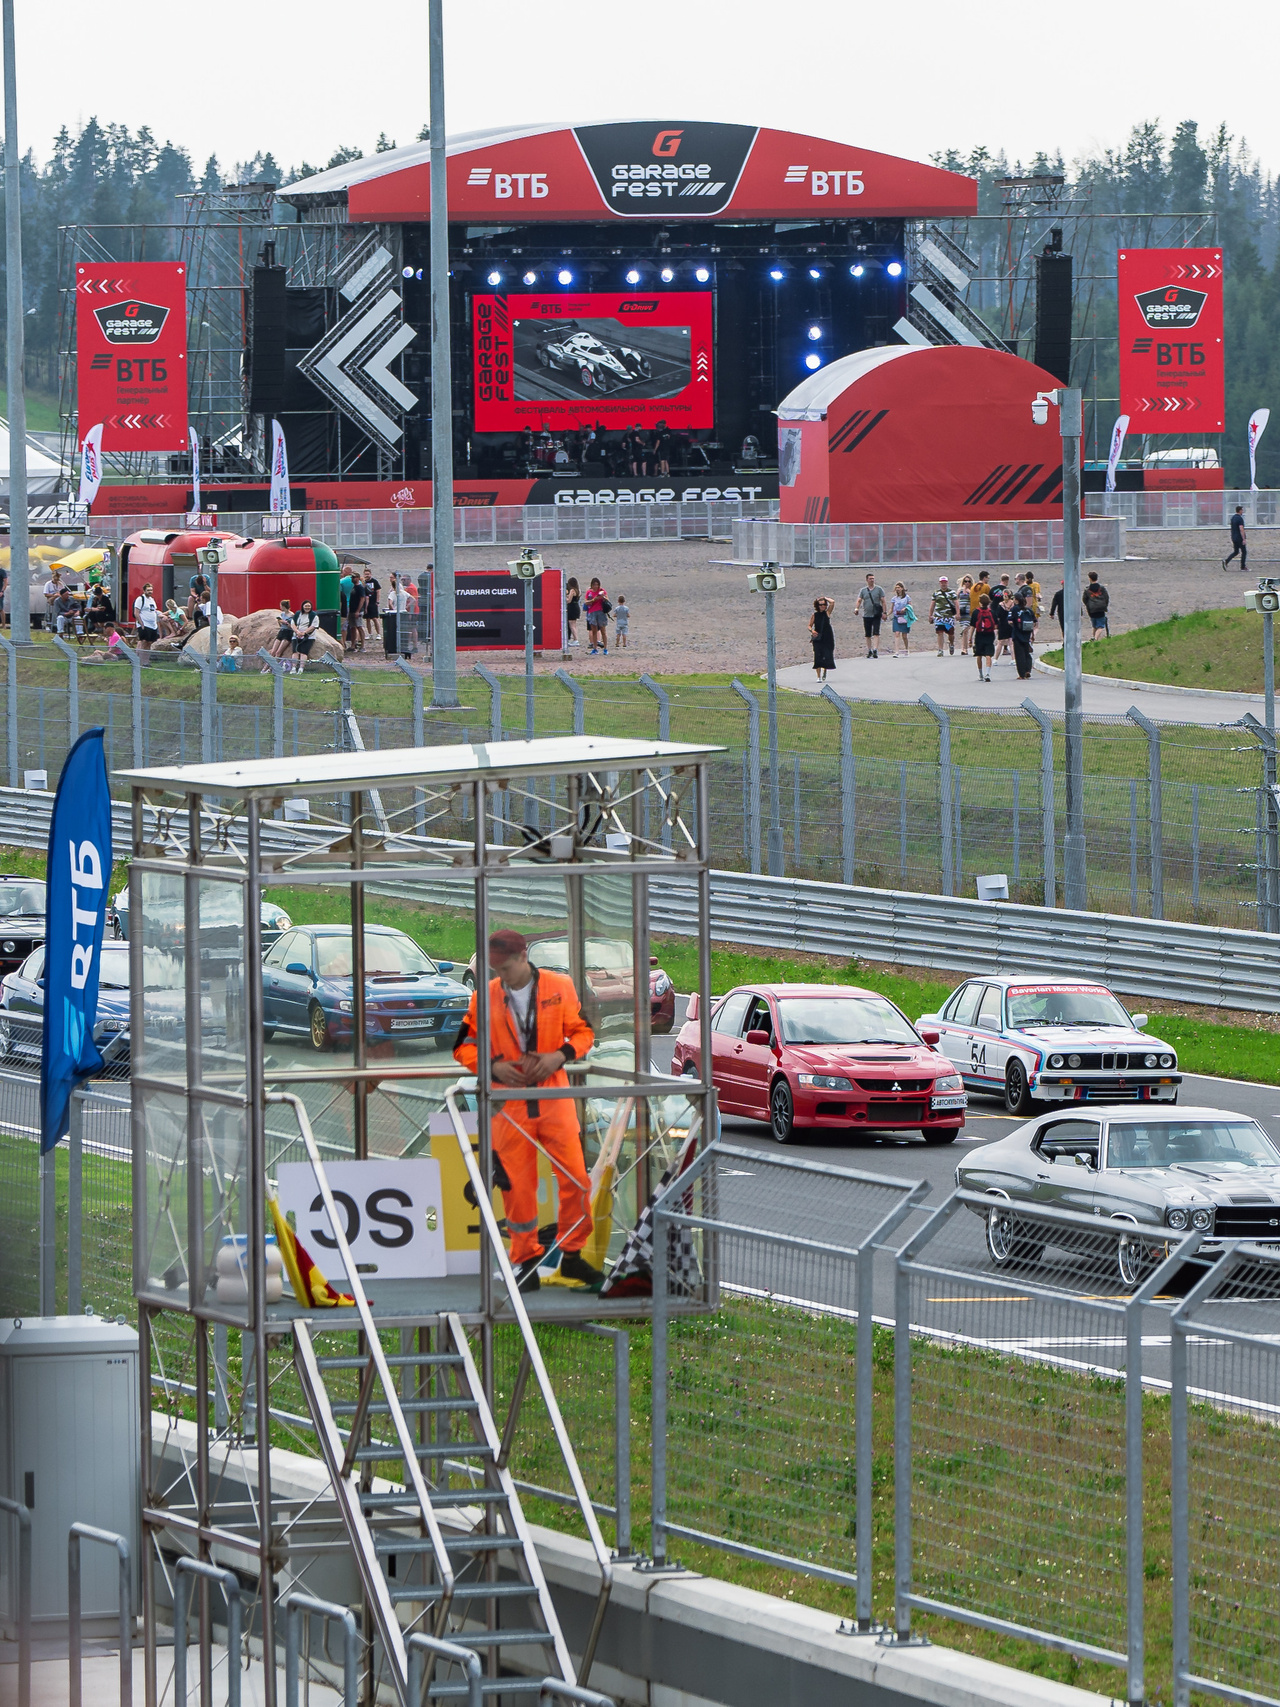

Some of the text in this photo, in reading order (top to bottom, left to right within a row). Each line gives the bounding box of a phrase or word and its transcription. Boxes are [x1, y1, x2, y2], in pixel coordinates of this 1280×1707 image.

[652, 130, 684, 157] G
[611, 163, 712, 180] GARAGE
[495, 173, 549, 198] ВТБ
[611, 181, 679, 197] FEST
[812, 170, 865, 196] ВТБ
[1164, 289, 1180, 302] G
[125, 304, 141, 317] G
[541, 304, 562, 314] ВТБ
[1147, 304, 1192, 313] GARAGE
[106, 319, 153, 328] GARAGE
[1147, 313, 1177, 321] FEST
[106, 327, 138, 336] FEST
[477, 302, 493, 402] GARAGE
[1157, 343, 1206, 366] ВТБ
[116, 359, 168, 382] ВТБ
[494, 335, 510, 402] FEST
[514, 404, 692, 415] ФЕСТИВАЛЬ АВТОМОБИЛЬНОЙ КУЛЬТУРЫ
[554, 486, 762, 507] GARAGE FEST
[315, 499, 339, 510] ВТБ
[456, 588, 518, 596] ГЛАВНАЯ СЦЕНА
[457, 620, 486, 628] ВЫХОД
[69, 839, 104, 990] ВТБ
[1011, 985, 1107, 995] Bavarian Motor Works
[970, 1044, 987, 1075] 54
